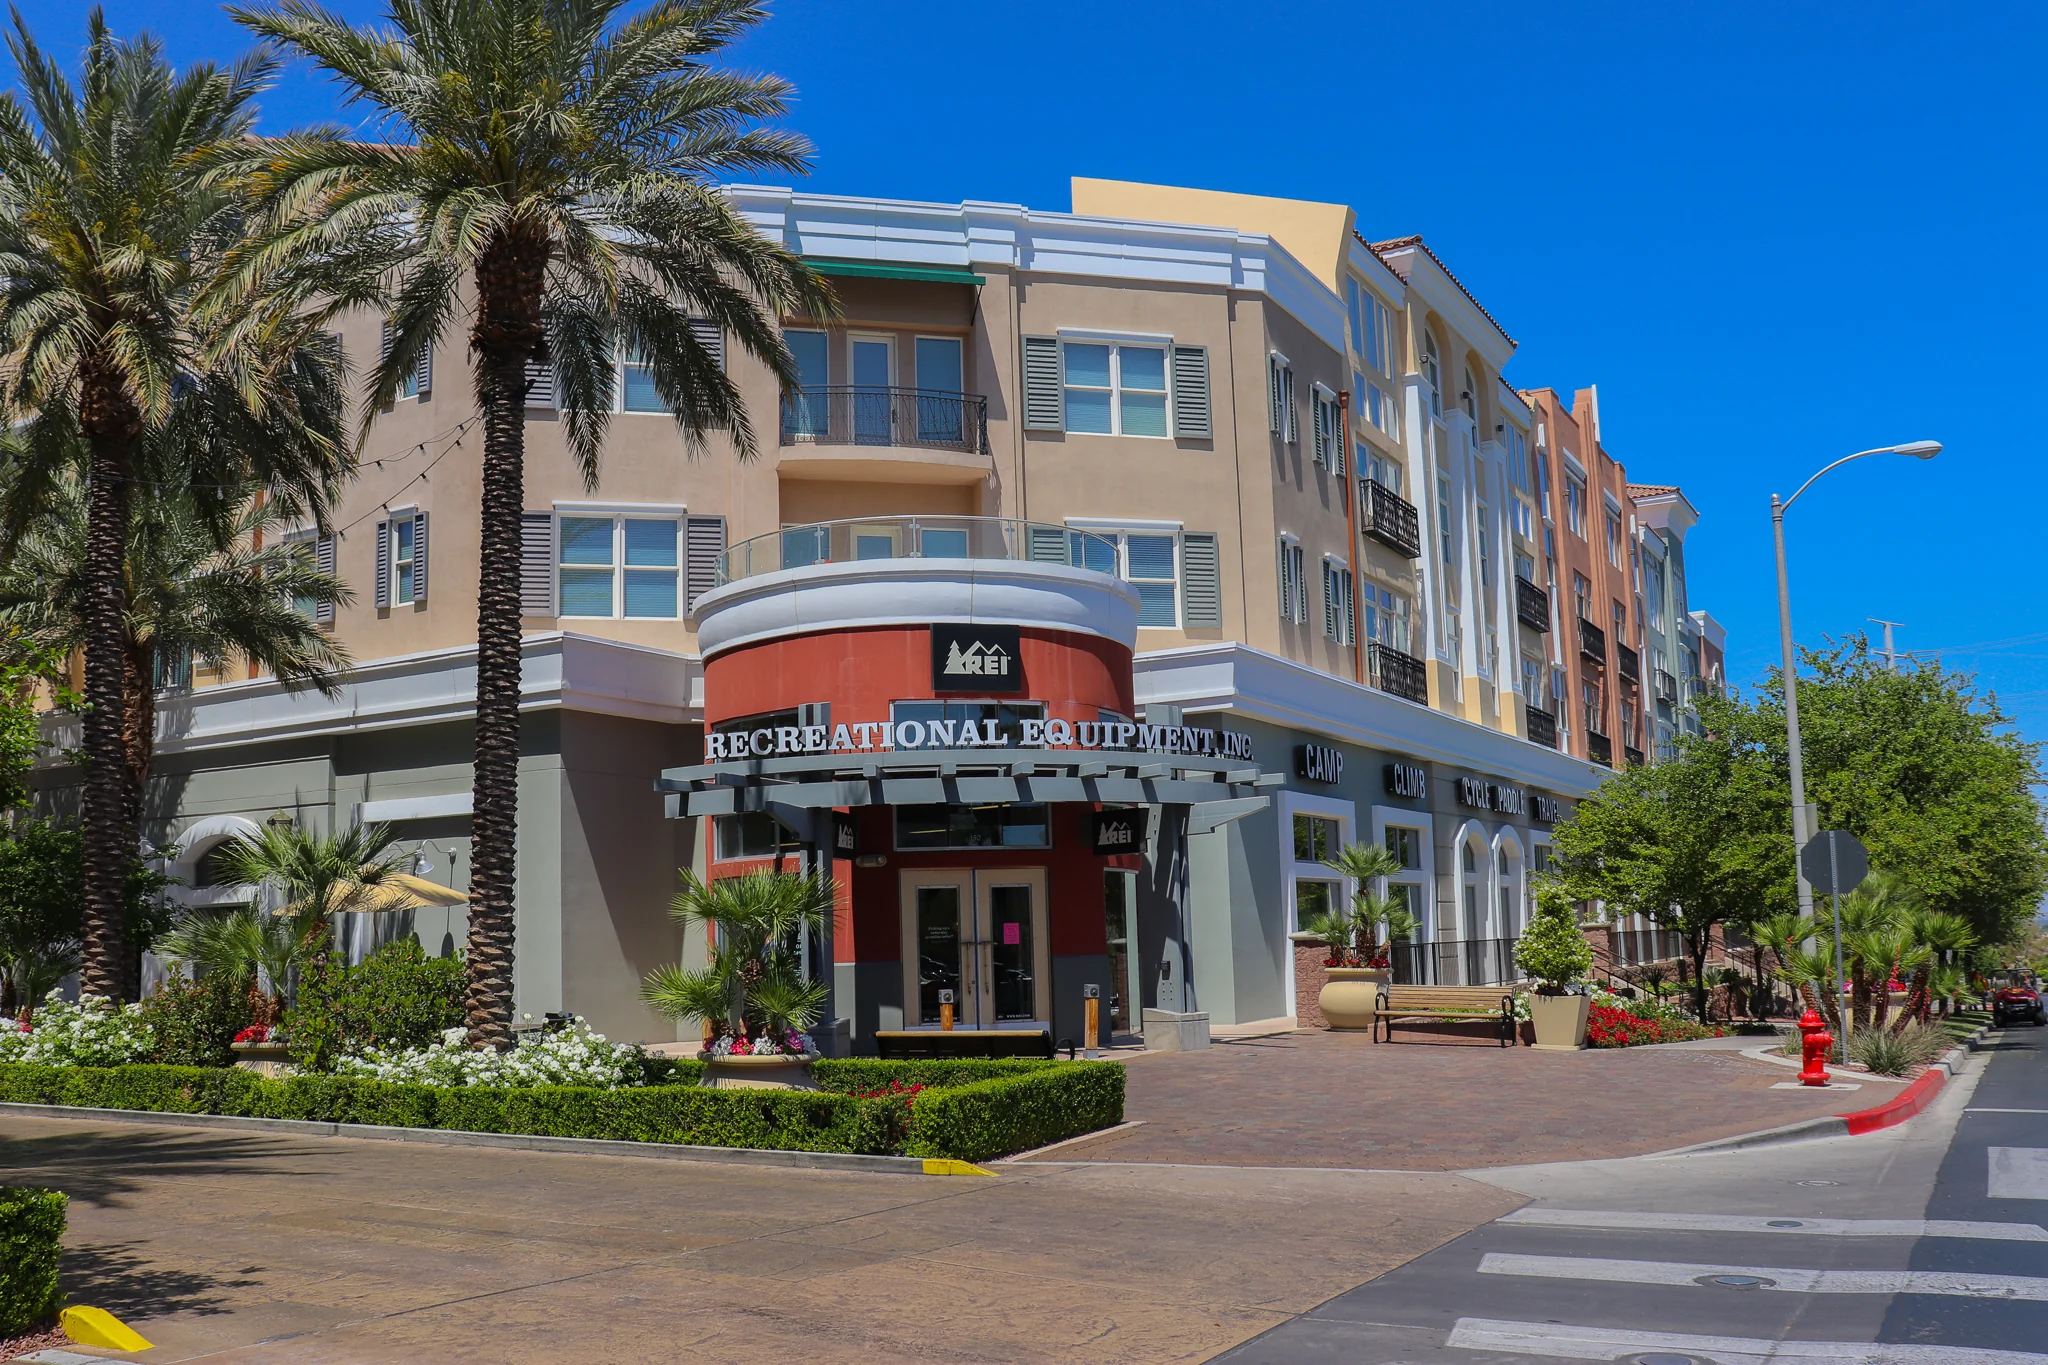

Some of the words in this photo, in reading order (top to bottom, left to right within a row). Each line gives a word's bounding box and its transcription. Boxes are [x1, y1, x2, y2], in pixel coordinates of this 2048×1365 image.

[965, 655, 1008, 675] REI
[705, 719, 1008, 760] RECREATIONAL
[1222, 730, 1255, 760] INC.
[1306, 743, 1344, 785] CAMP
[1394, 763, 1426, 799] CLIMB
[1463, 776, 1491, 809] CYCLE
[1498, 785, 1526, 815] PADDLE
[1108, 829, 1132, 844] REI
